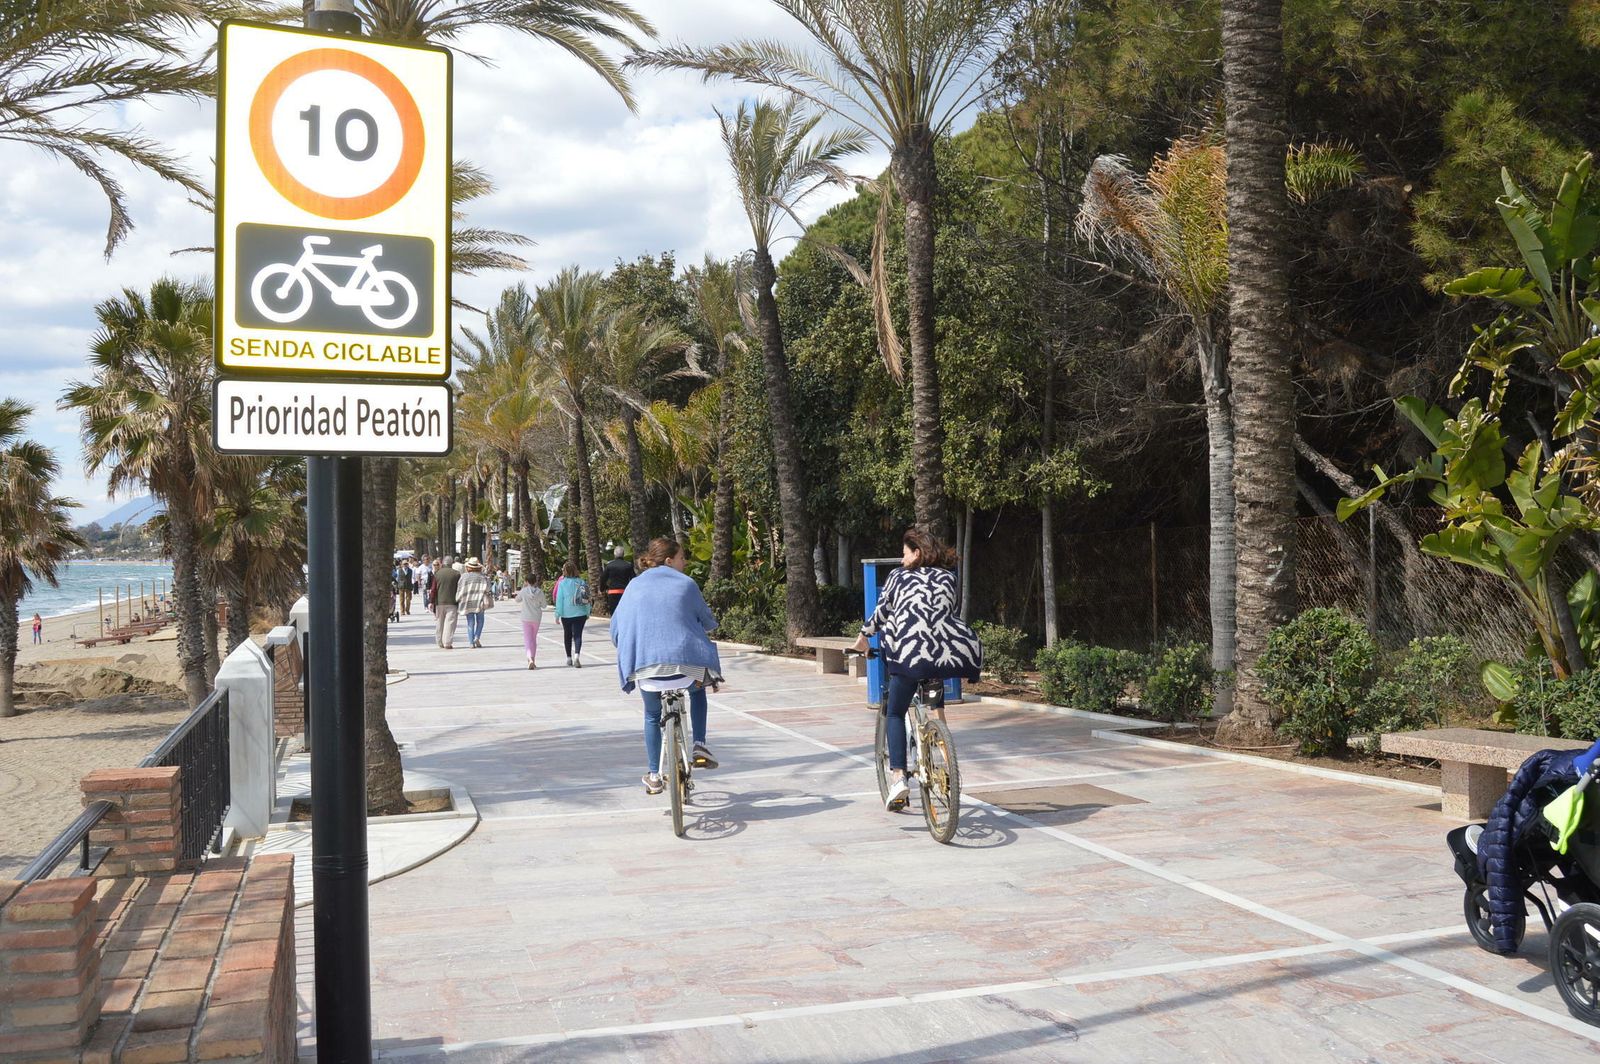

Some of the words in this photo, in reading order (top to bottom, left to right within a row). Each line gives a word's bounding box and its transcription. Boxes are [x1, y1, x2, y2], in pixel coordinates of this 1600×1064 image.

[299, 104, 379, 162] 10
[230, 338, 315, 359] SENDA
[323, 343, 441, 364] CICLABLE
[230, 395, 347, 435] Prioridad
[357, 397, 441, 437] Peatón
